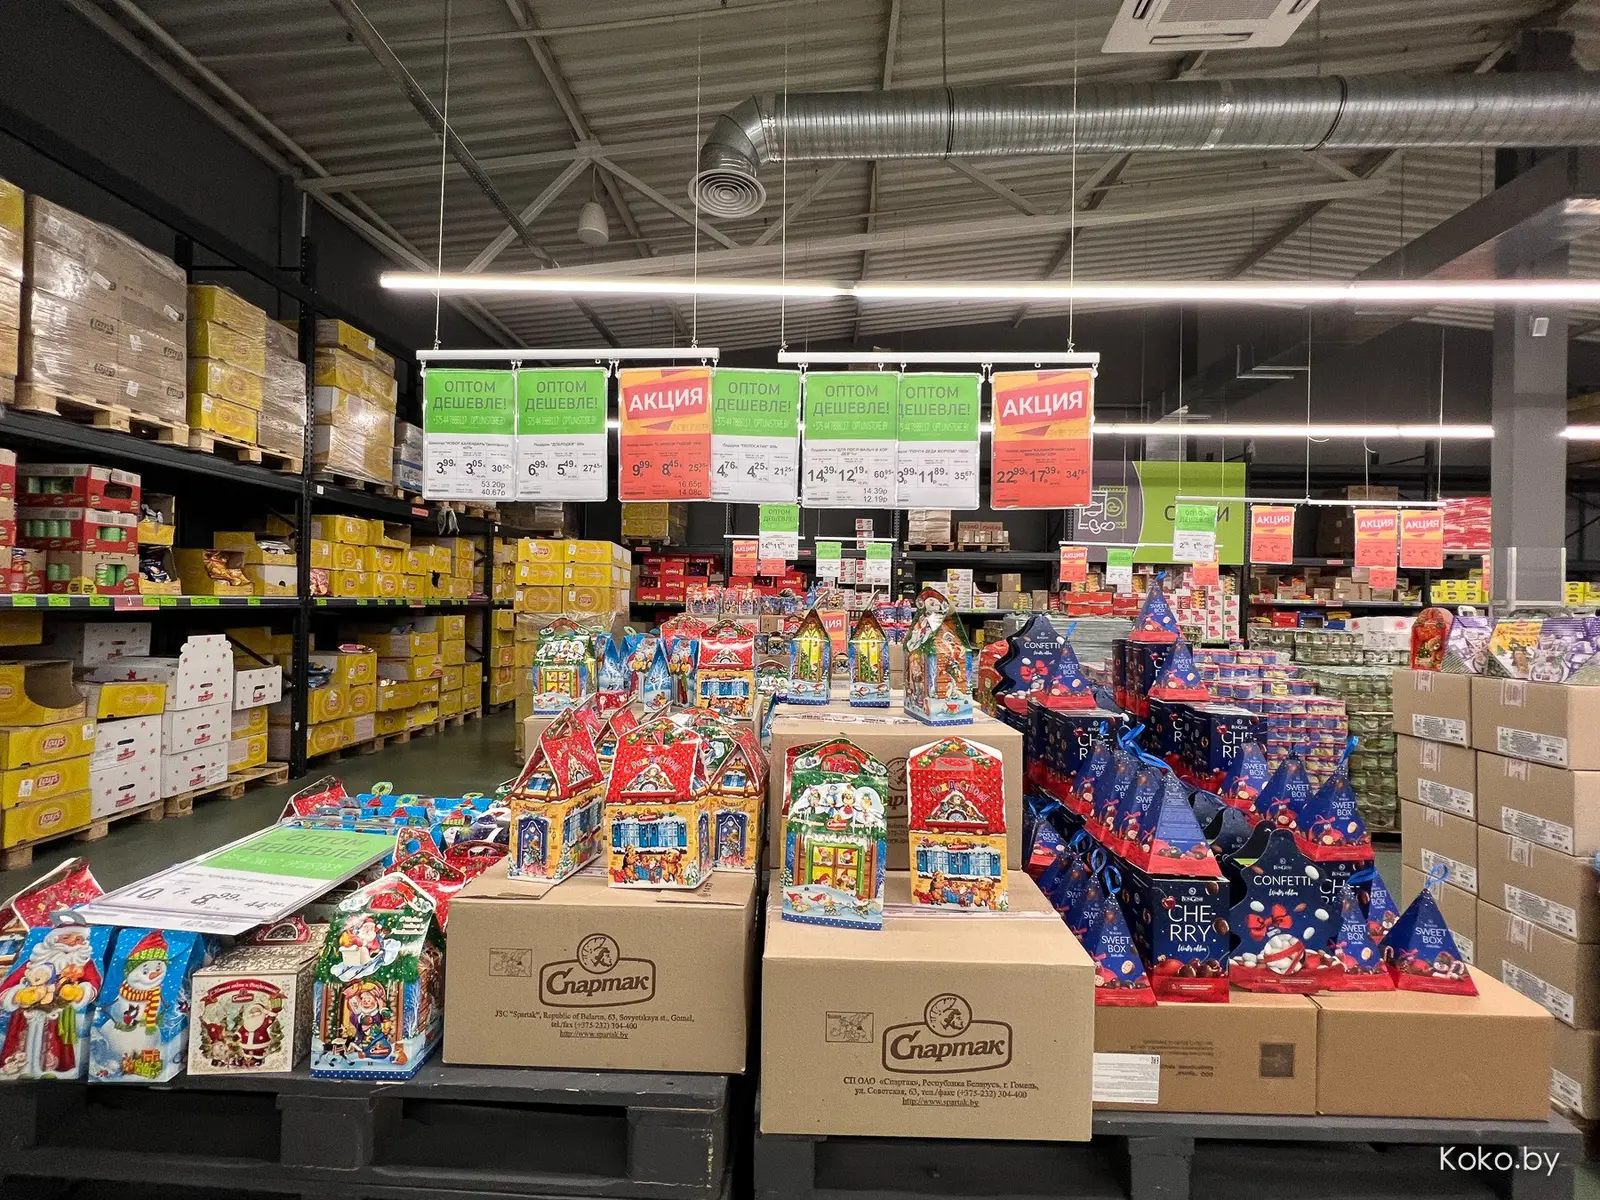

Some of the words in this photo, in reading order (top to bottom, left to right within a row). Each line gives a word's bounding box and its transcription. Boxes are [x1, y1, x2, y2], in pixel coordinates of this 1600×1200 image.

[444, 381, 496, 393] ОПТОМ
[537, 381, 587, 393] ОПТОМ
[728, 382, 780, 395] ОПТОМ
[825, 385, 878, 397] ОПТОМ
[905, 387, 959, 398] ОПТОМ
[433, 397, 506, 410] ДЕШЕВЛЕ!
[525, 397, 598, 412] ДЕШЕВЛЕ!
[628, 387, 703, 413] АКЦИЯ
[1002, 390, 1083, 418] АКЦИЯ
[715, 399, 791, 413] ДЕШЕВЛЕ!
[813, 402, 890, 416] ДЕШЕВЛЕ!
[1256, 515, 1290, 524] АКЦИЯ
[1360, 519, 1394, 529] АКЦИЯ
[1405, 520, 1440, 529] АКЦИЯ
[1243, 762, 1267, 770] SWEET
[1332, 801, 1356, 809] SWEET
[1336, 808, 1353, 816] BOX
[286, 834, 369, 846] ОПТОМ
[239, 841, 369, 860] ДЕШЕВЛЕ!
[1371, 890, 1387, 898] WEET
[1168, 904, 1217, 923] CHE-
[1341, 923, 1367, 933] SWEET
[1415, 926, 1447, 937] SWEET
[1101, 935, 1130, 945] SWEET
[1347, 932, 1365, 941] BOX
[1422, 935, 1443, 944] BOX
[1107, 944, 1127, 953] BOX
[546, 967, 650, 997] Спартак
[494, 1010, 508, 1018] JSC
[543, 1012, 572, 1021] Republic
[619, 1013, 659, 1023] Sovyetskaya
[670, 1014, 694, 1023] Gomel,
[611, 1022, 638, 1030] 304-400
[890, 1030, 1005, 1062] Спартак
[843, 1076, 857, 1085] СП
[857, 1077, 876, 1085] ОАО
[922, 1078, 965, 1088] Республика
[1010, 1081, 1039, 1090] Гомель,
[854, 1088, 866, 1096] ул.
[908, 1088, 920, 1097] 63,
[956, 1089, 996, 1099] (+375-232)
[997, 1090, 1027, 1099] 304-400
[901, 1097, 979, 1108] http://www.spartak.by
